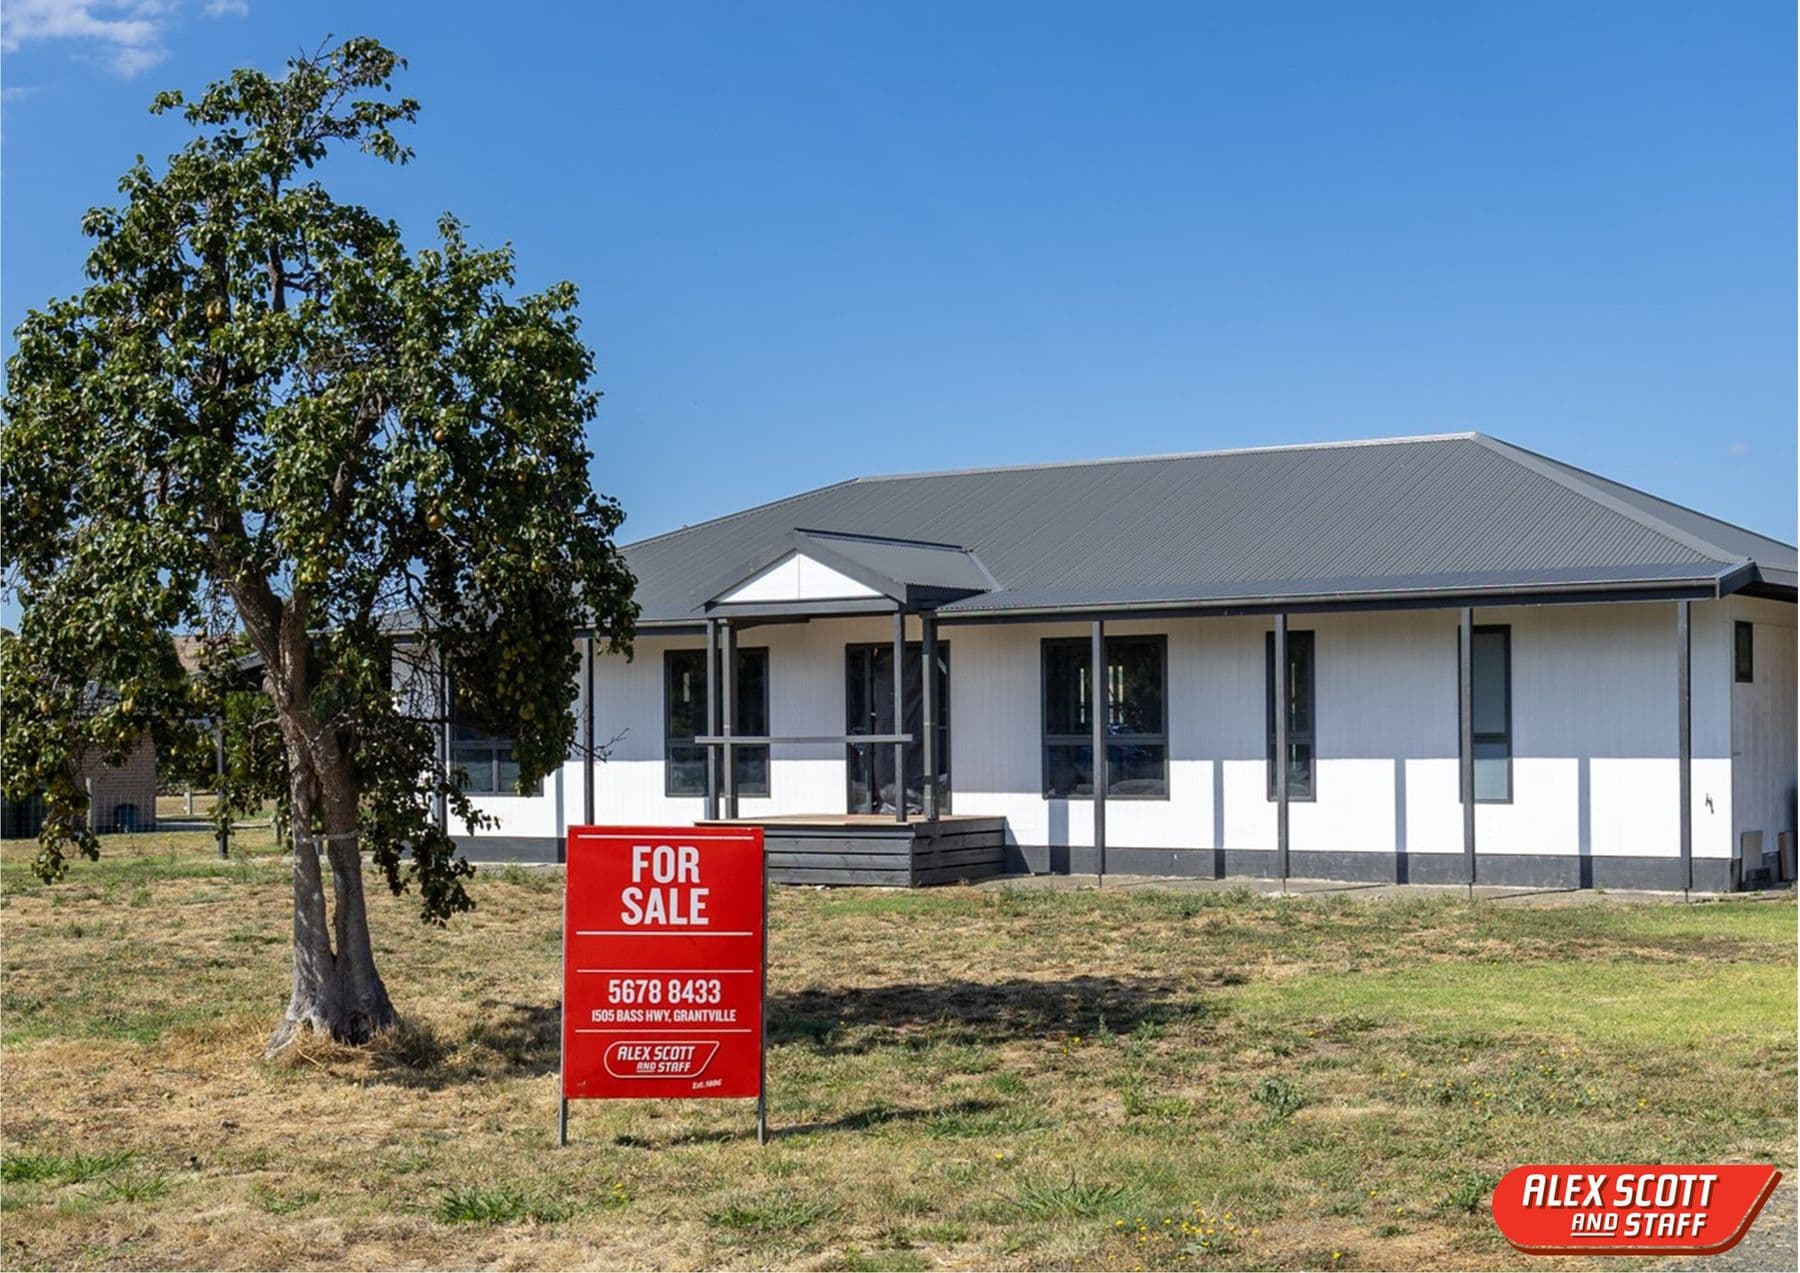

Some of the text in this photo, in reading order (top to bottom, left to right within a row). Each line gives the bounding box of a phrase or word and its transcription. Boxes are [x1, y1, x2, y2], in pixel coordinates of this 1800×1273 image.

[631, 845, 701, 884] FOR
[620, 886, 710, 926] SALE
[608, 979, 721, 1004] 5678 8433
[591, 1009, 737, 1024] 1505 BASS HWY, GRANTVILLE
[617, 1045, 696, 1061] ALEX SCOTT
[636, 1061, 692, 1073] AND STAFF
